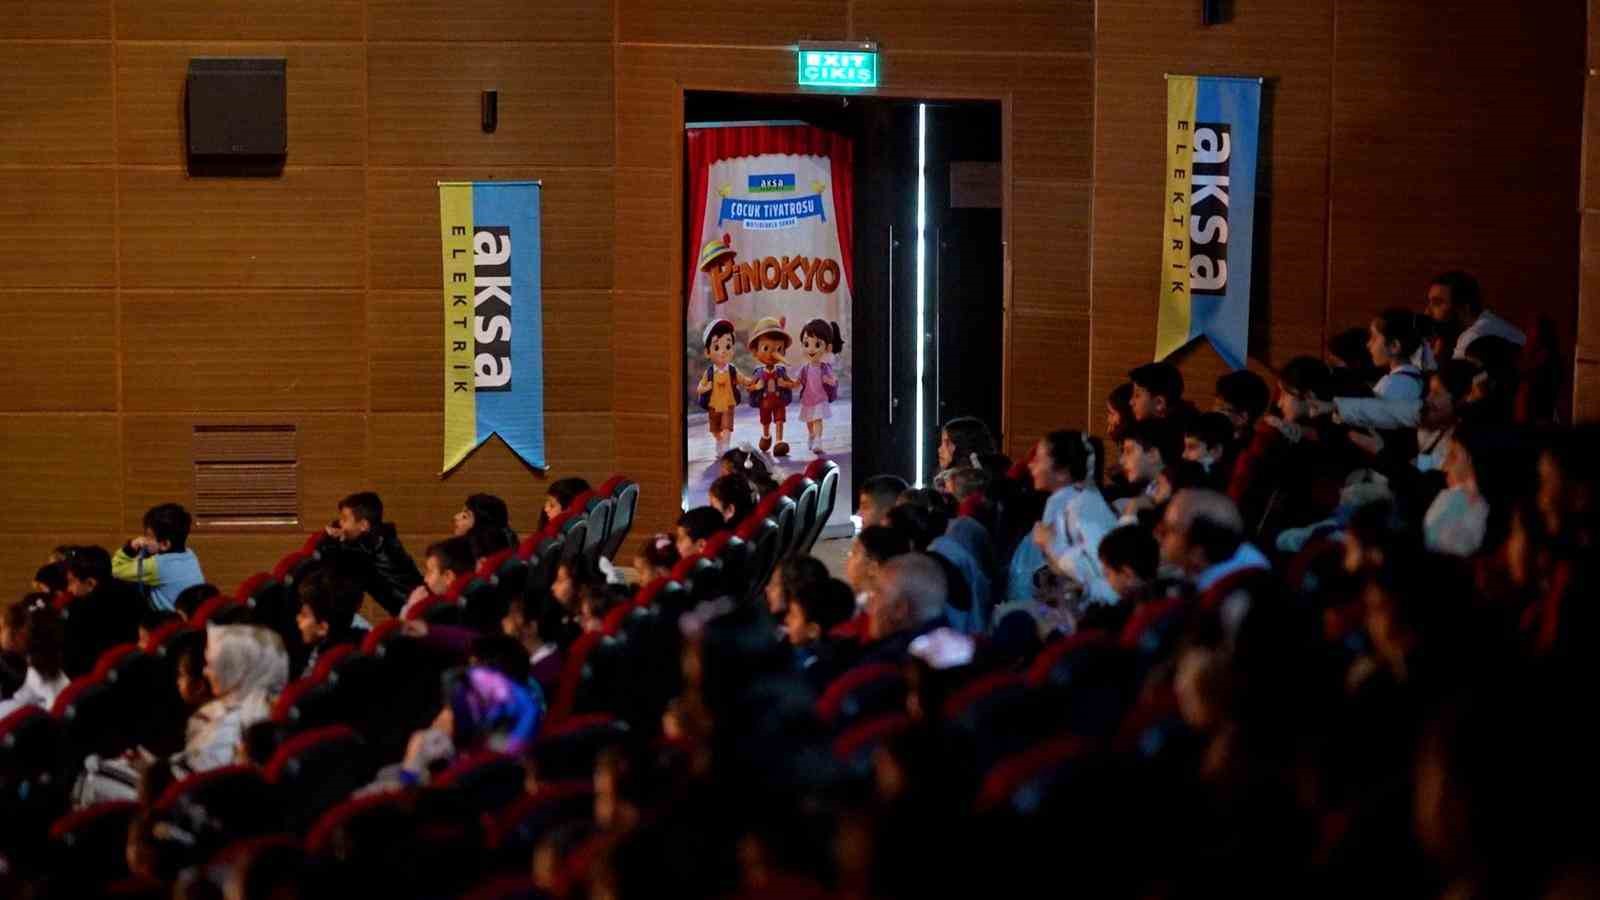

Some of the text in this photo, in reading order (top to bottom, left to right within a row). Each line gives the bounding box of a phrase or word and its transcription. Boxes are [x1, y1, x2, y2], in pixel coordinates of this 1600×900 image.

[806, 53, 864, 67] EXIT
[731, 202, 760, 218] ÇOCUK
[1190, 127, 1230, 290] aksa
[452, 226, 470, 392] ELEKTRİK
[473, 231, 512, 388] aksa
